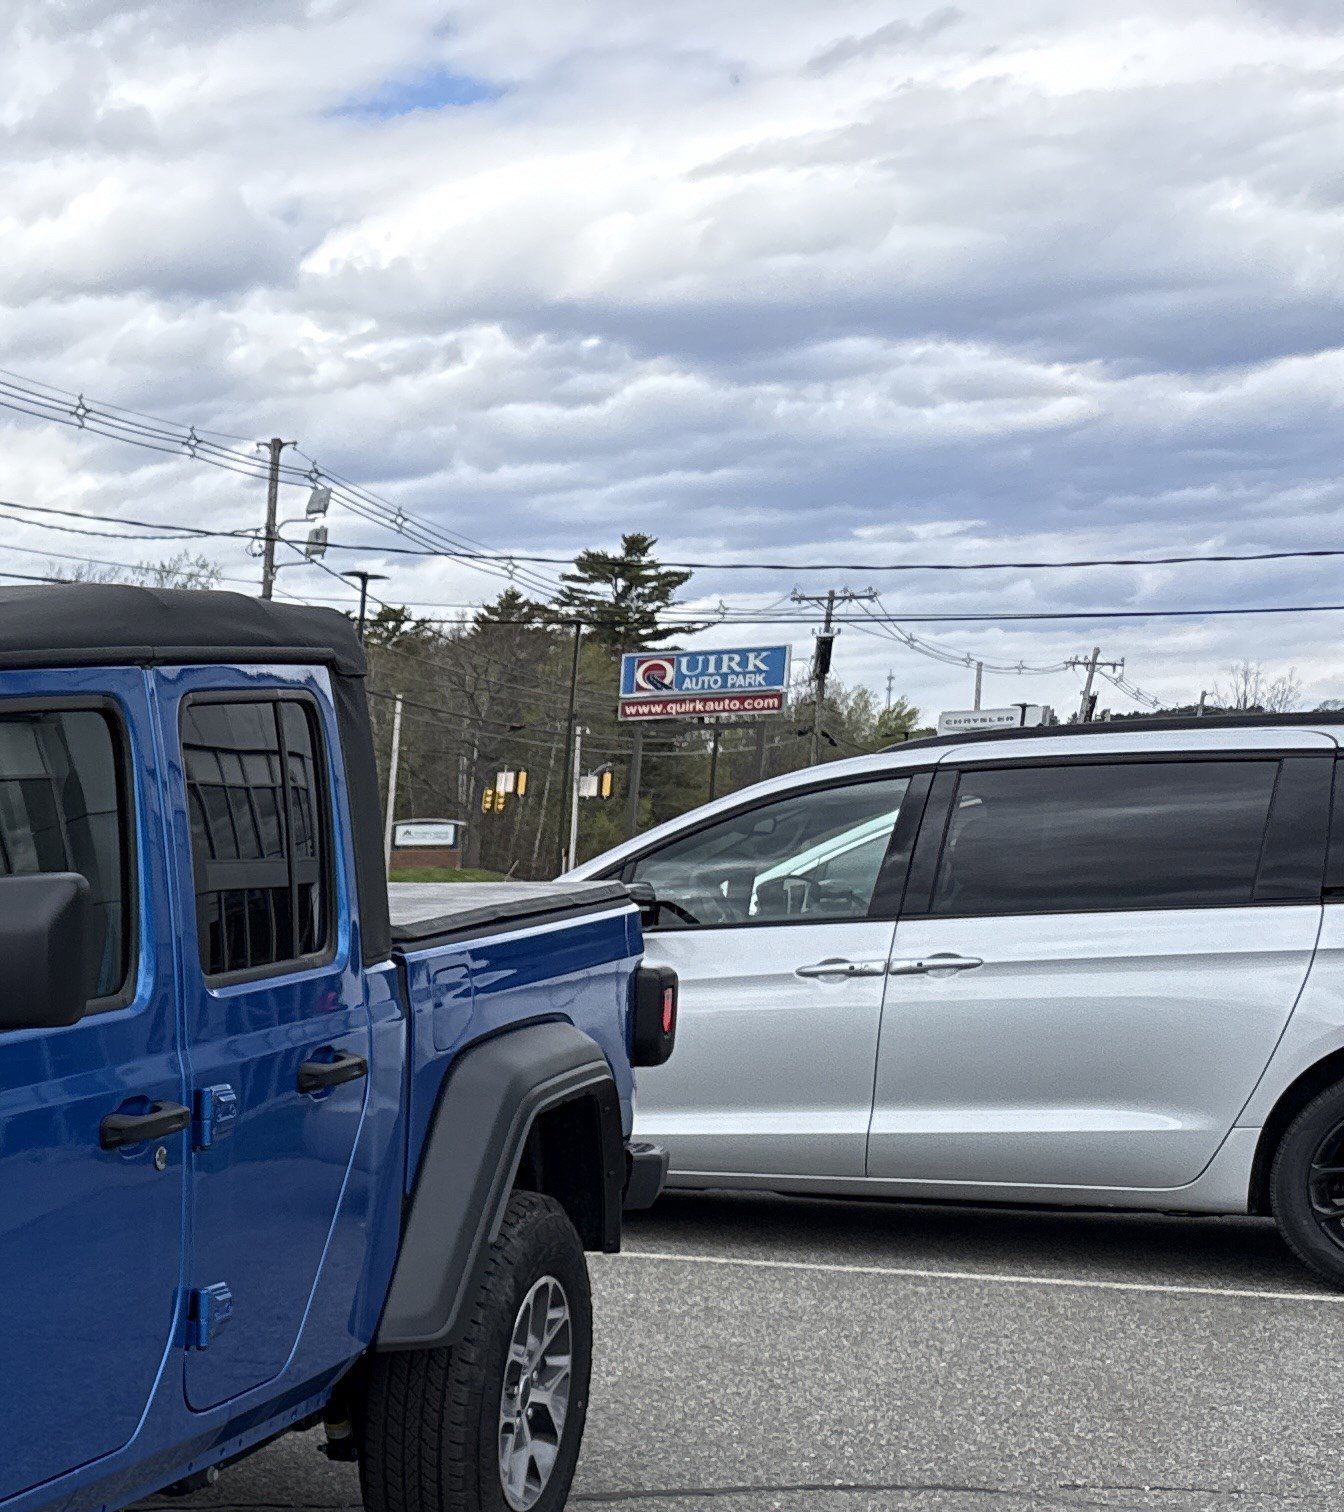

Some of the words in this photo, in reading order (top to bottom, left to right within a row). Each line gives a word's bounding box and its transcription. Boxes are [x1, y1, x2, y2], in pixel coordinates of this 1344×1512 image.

[635, 651, 771, 692] QUIRK
[682, 674, 722, 690] AUTO
[727, 672, 766, 688] PARK
[624, 697, 779, 716] www.quirkauto.com
